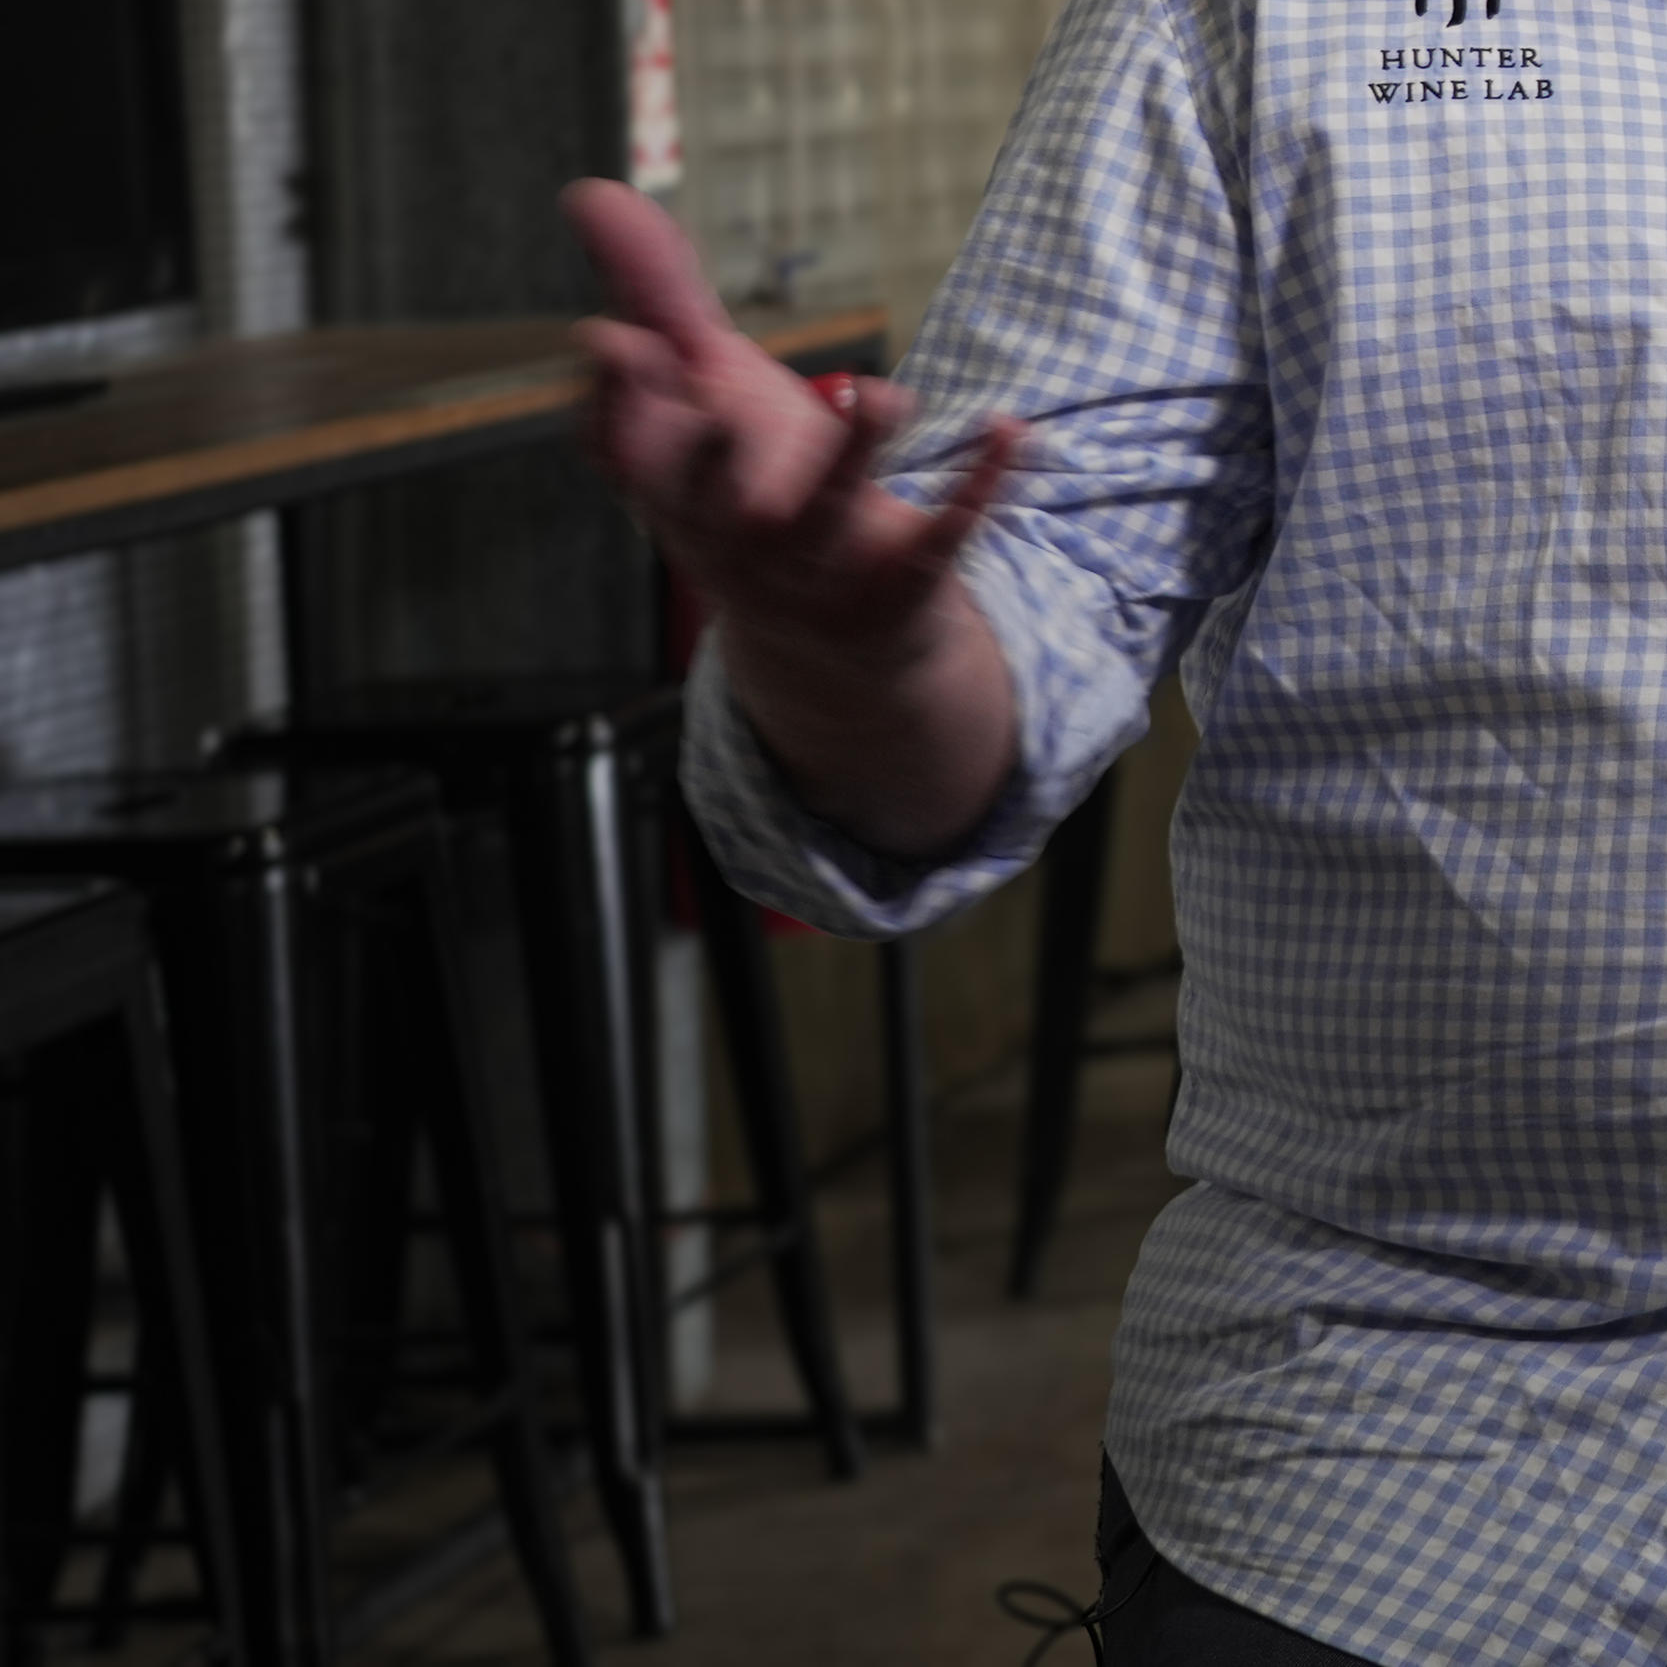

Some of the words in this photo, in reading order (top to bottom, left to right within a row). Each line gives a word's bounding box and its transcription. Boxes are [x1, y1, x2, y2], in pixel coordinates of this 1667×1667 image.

[1380, 47, 1543, 70] HUNTER
[1367, 80, 1469, 104] WINE
[1484, 79, 1555, 101] LAB
